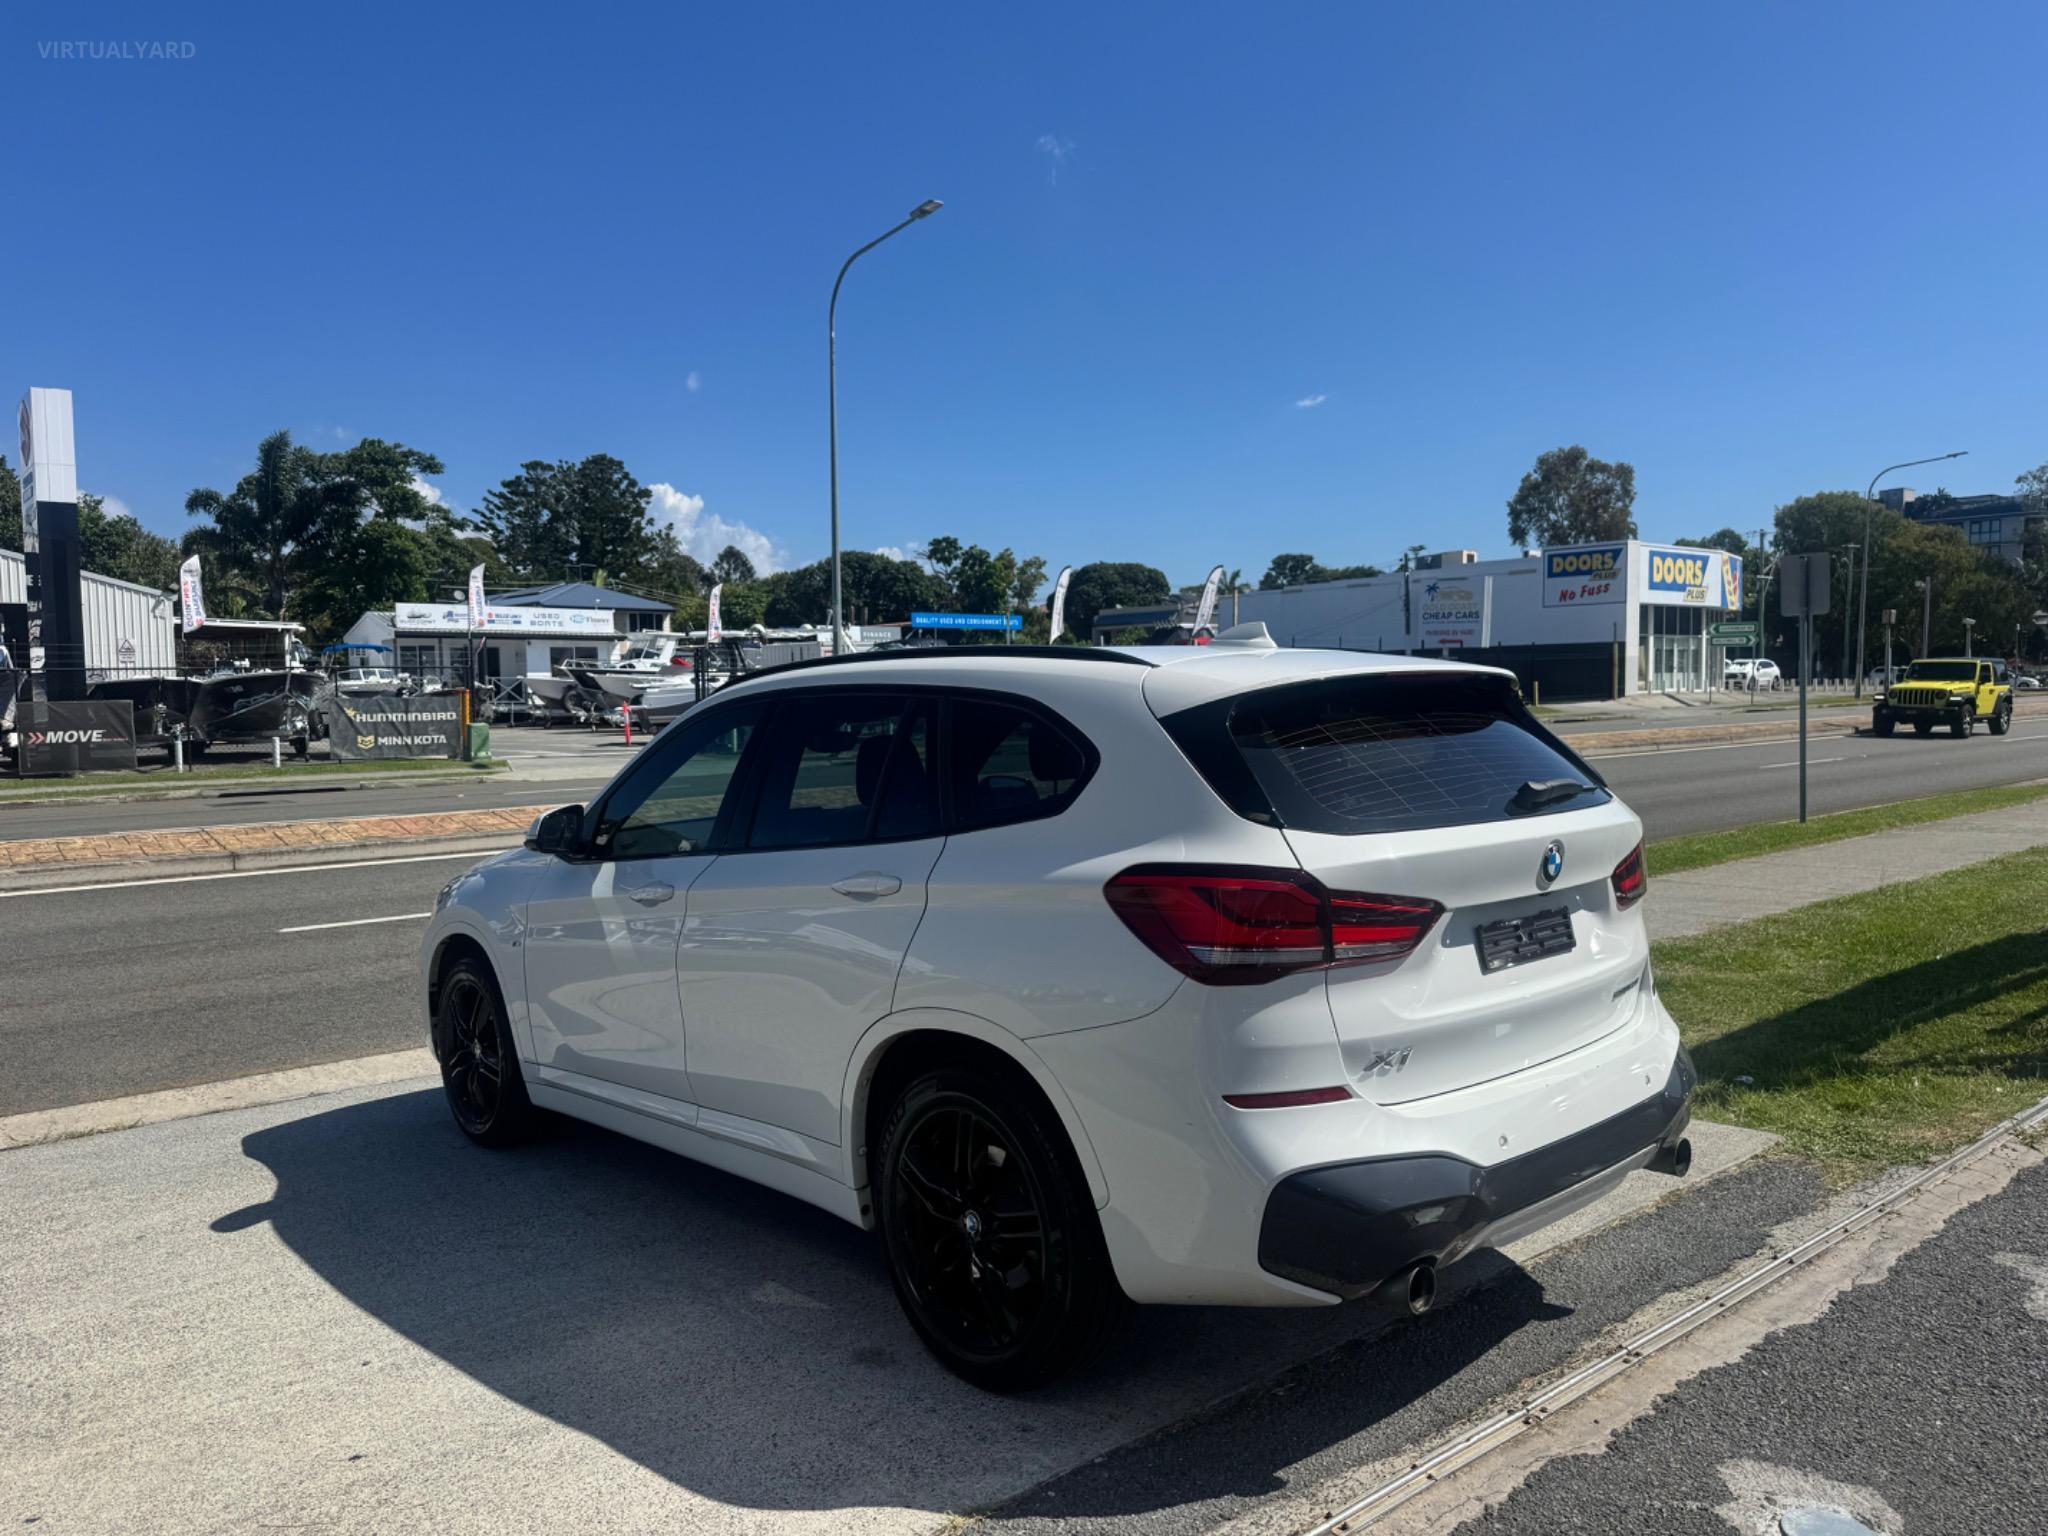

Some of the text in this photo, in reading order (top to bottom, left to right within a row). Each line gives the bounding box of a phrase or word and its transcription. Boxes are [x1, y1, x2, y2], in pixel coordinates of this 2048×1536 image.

[1552, 552, 1614, 574] DOORS
[1653, 556, 1703, 586] DOORS
[1559, 583, 1610, 603] No Fuss
[1686, 590, 1705, 599] PLUS
[1422, 610, 1480, 620] CHEAP CARS
[356, 711, 457, 722] HUMMINBIRD
[45, 729, 107, 743] MOVE
[377, 735, 447, 746] MINN KOTA
[1362, 1048, 1412, 1072] X1
